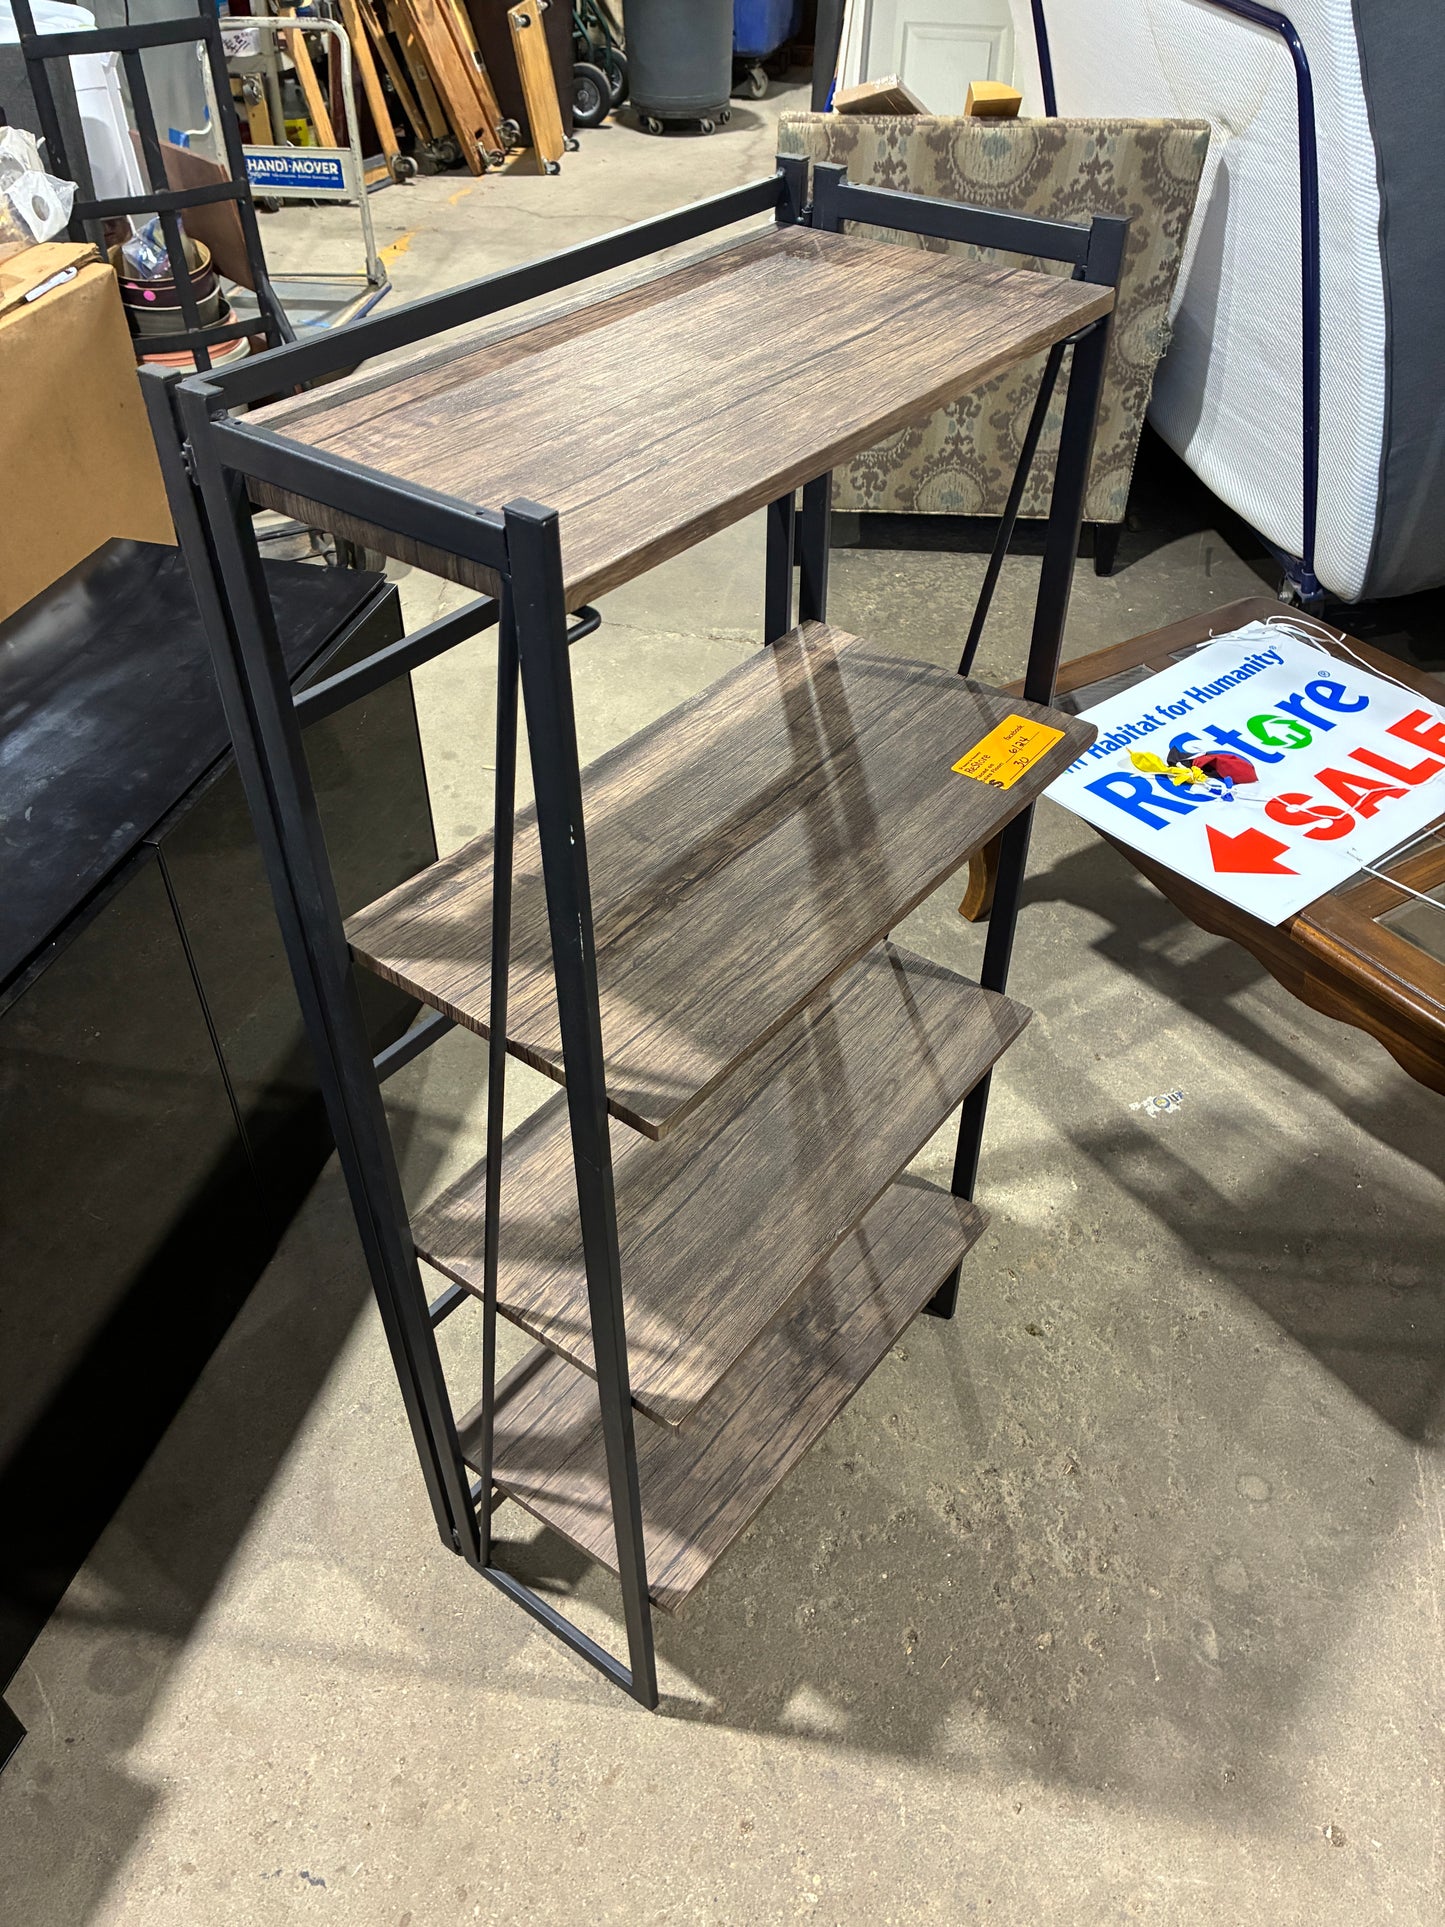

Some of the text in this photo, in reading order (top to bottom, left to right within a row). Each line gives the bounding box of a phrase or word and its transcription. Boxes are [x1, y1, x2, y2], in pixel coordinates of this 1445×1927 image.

[1087, 648, 1285, 760] Habitat for Humanity
[964, 754, 991, 775] ReStore
[1264, 709, 1445, 841] SALE
